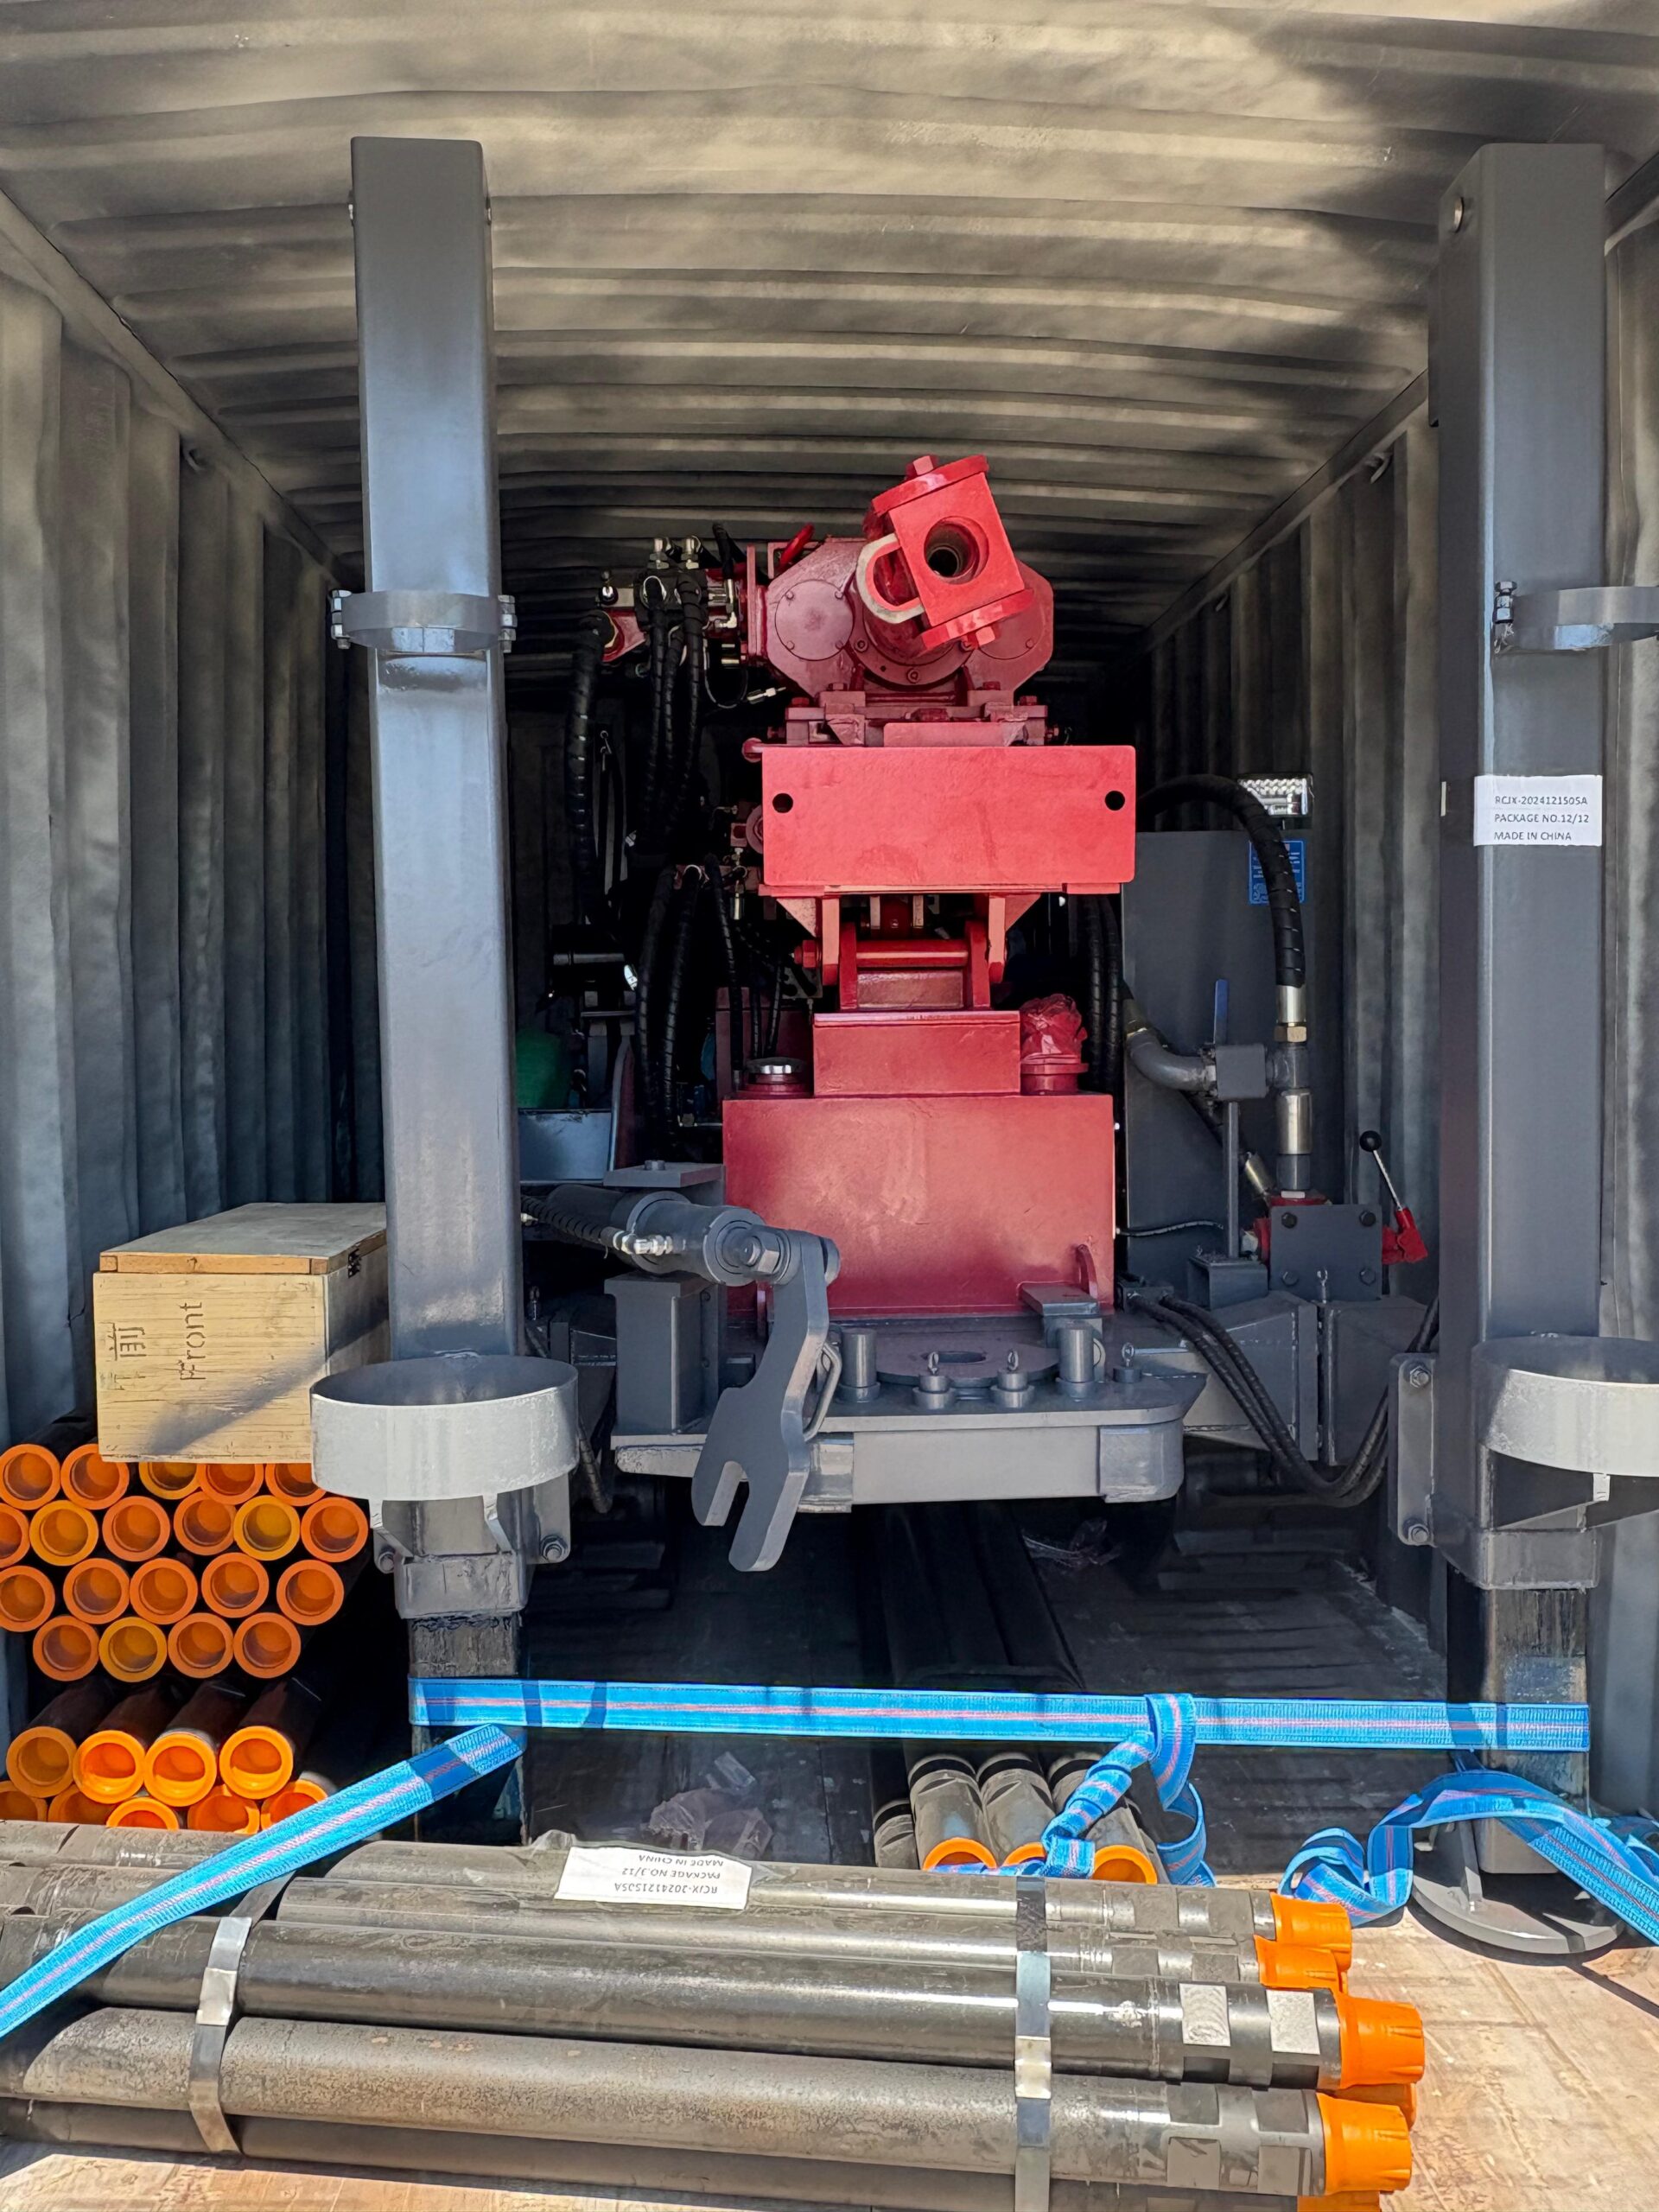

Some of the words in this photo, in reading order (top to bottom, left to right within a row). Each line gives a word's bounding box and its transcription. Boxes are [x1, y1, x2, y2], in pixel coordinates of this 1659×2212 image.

[1494, 796, 1588, 805] RCJX-2024121505A
[1494, 814, 1539, 823] PACKAGE
[1541, 814, 1589, 824] NO.12/12
[1493, 831, 1523, 841] MADE
[1527, 831, 1537, 840] IN
[1540, 831, 1572, 840] CHINA
[177, 1301, 207, 1381] Front
[638, 1854, 672, 1865] CHINA
[675, 1858, 688, 1866] IN
[690, 1859, 724, 1867] MADE
[671, 1870, 721, 1879] PACKAGE
